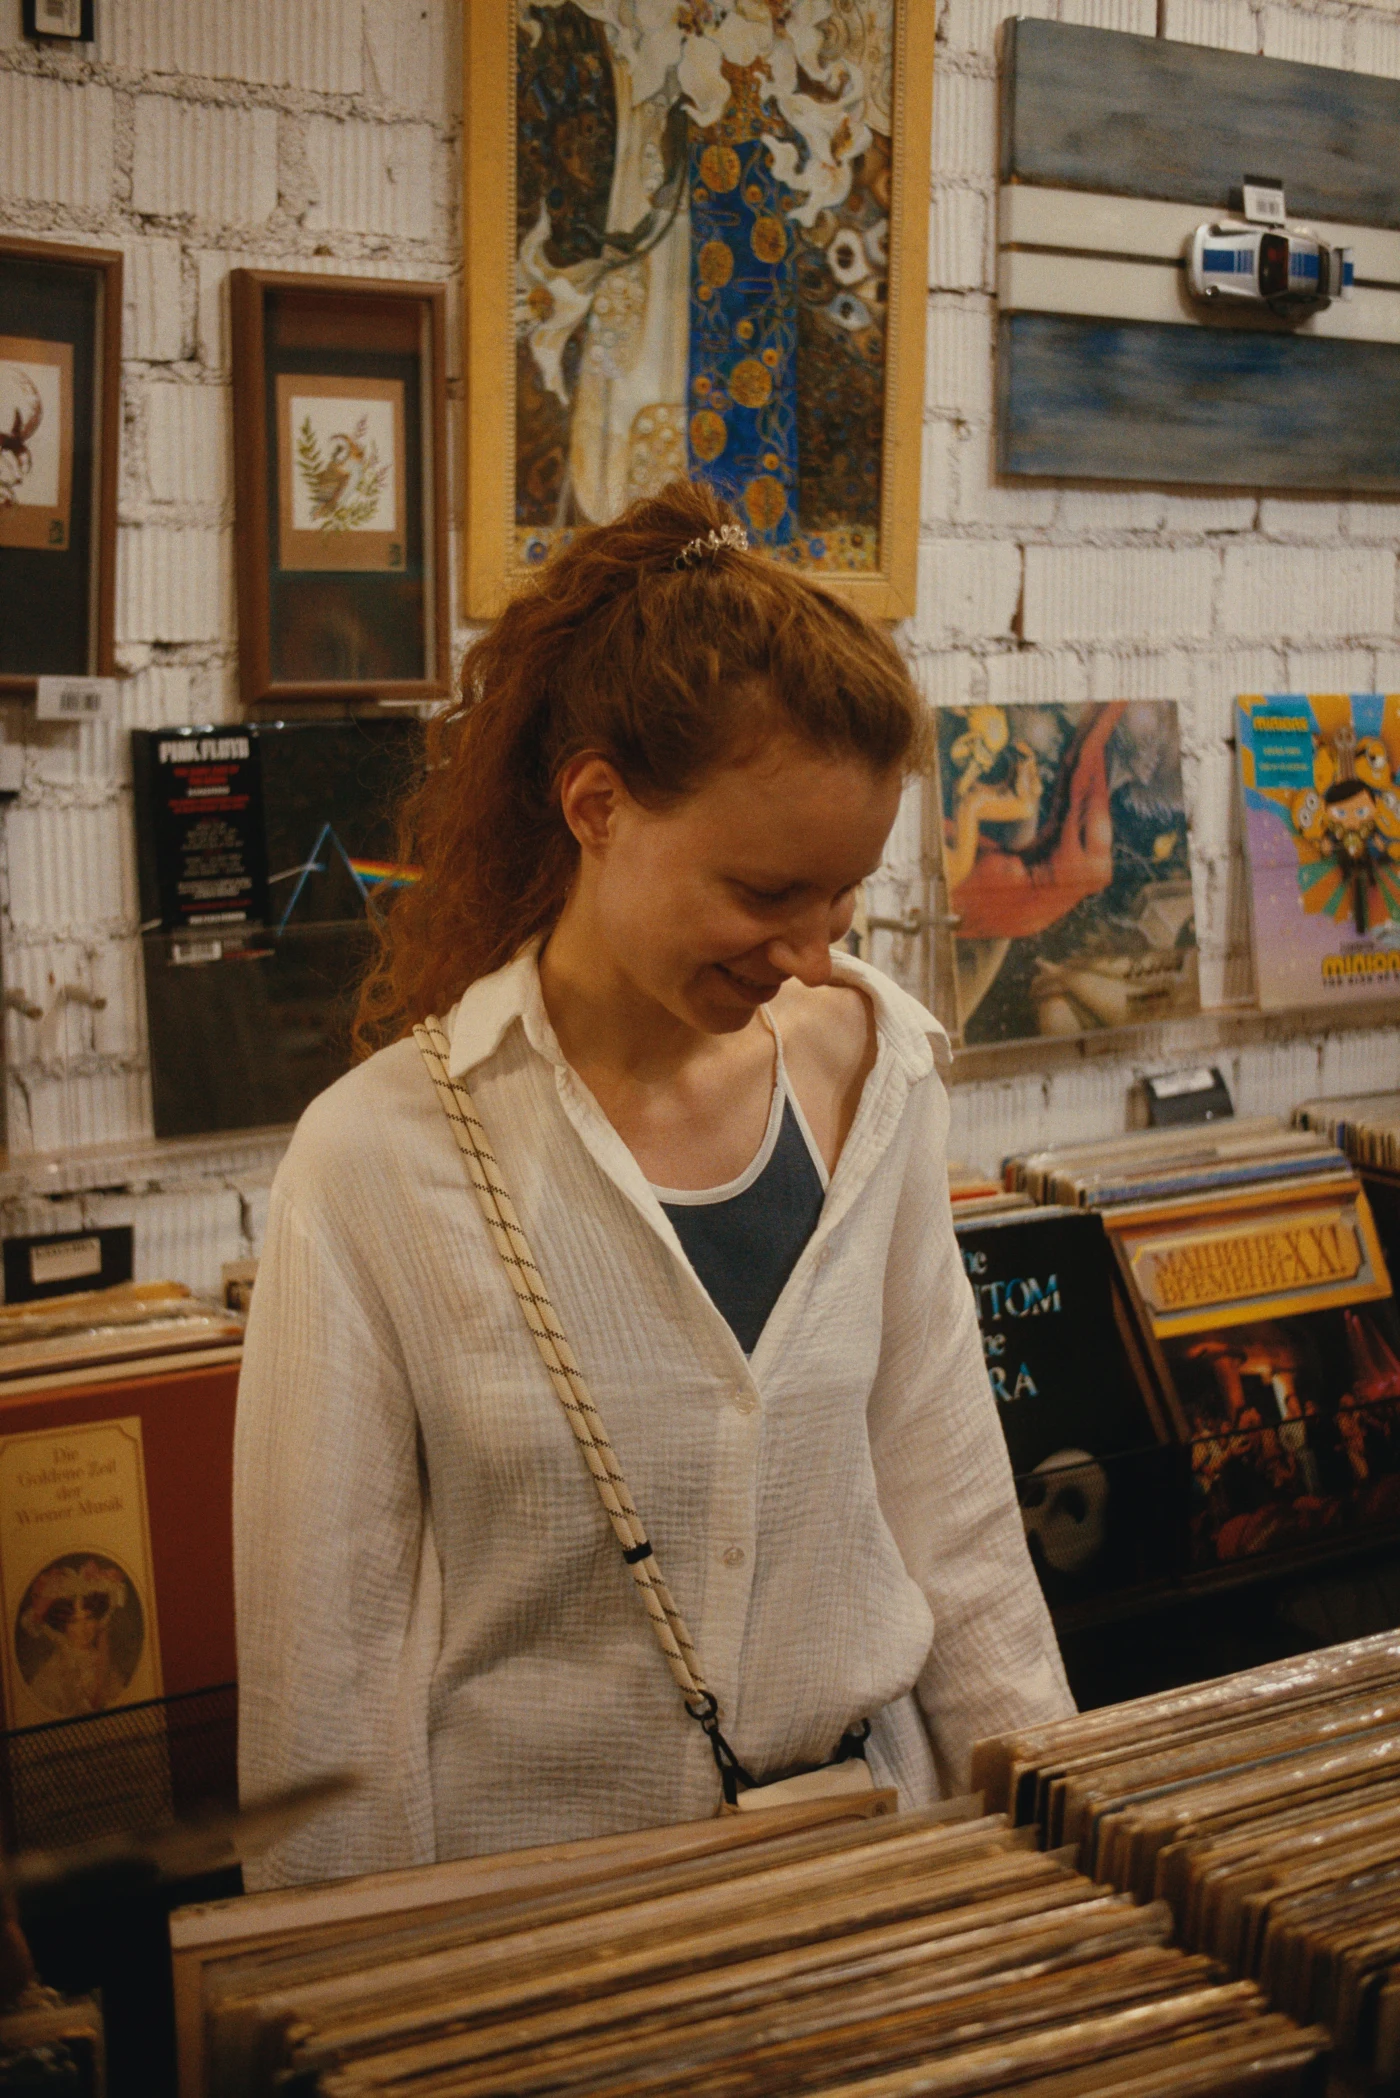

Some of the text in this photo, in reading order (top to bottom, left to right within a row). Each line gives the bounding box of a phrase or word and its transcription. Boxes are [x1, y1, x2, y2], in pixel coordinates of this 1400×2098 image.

[16, 1466, 84, 1488] Goldene
[15, 1494, 124, 1525] Wiener Musik
